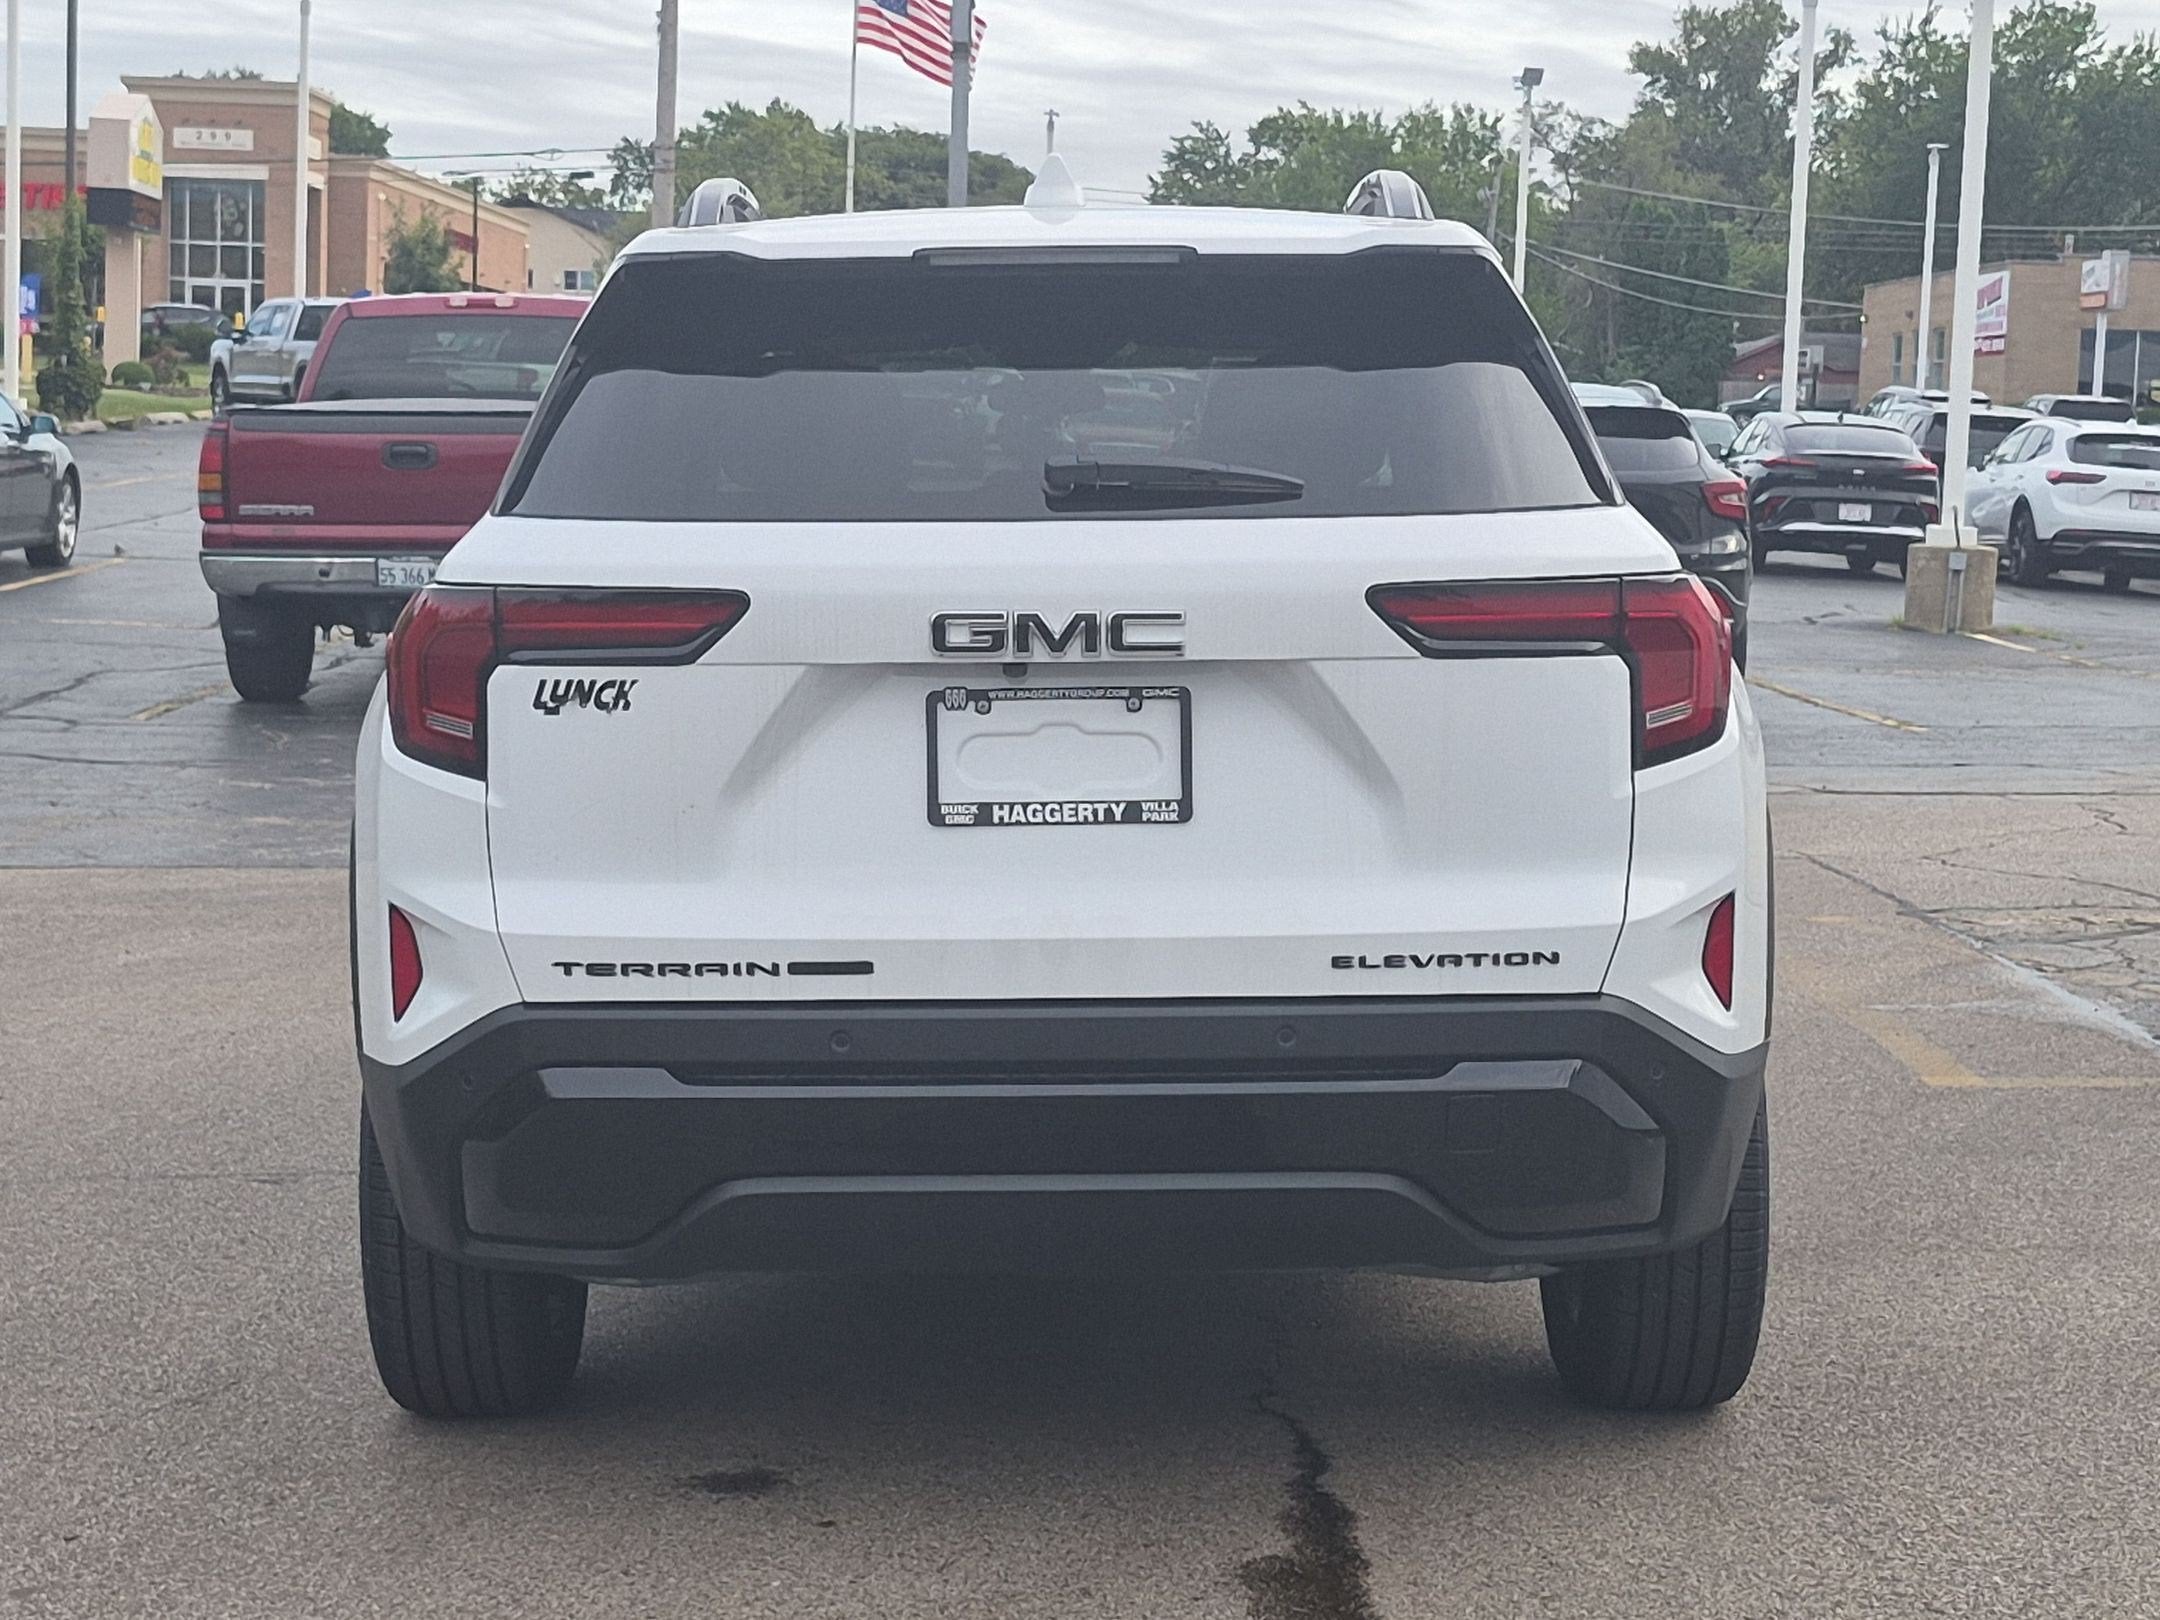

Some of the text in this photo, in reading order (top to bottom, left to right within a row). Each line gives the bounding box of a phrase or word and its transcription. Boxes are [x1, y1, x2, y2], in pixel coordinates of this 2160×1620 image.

[931, 610, 1186, 658] GMC
[1142, 687, 1180, 697] GMC
[940, 804, 979, 815] BUICK
[1140, 801, 1179, 812] VILLA
[991, 802, 1128, 824] HAGGERTY
[1142, 811, 1180, 822] PARK
[945, 814, 975, 825] GMC
[1331, 951, 1560, 969] ELEVATION
[551, 961, 781, 977] TERRAIN
